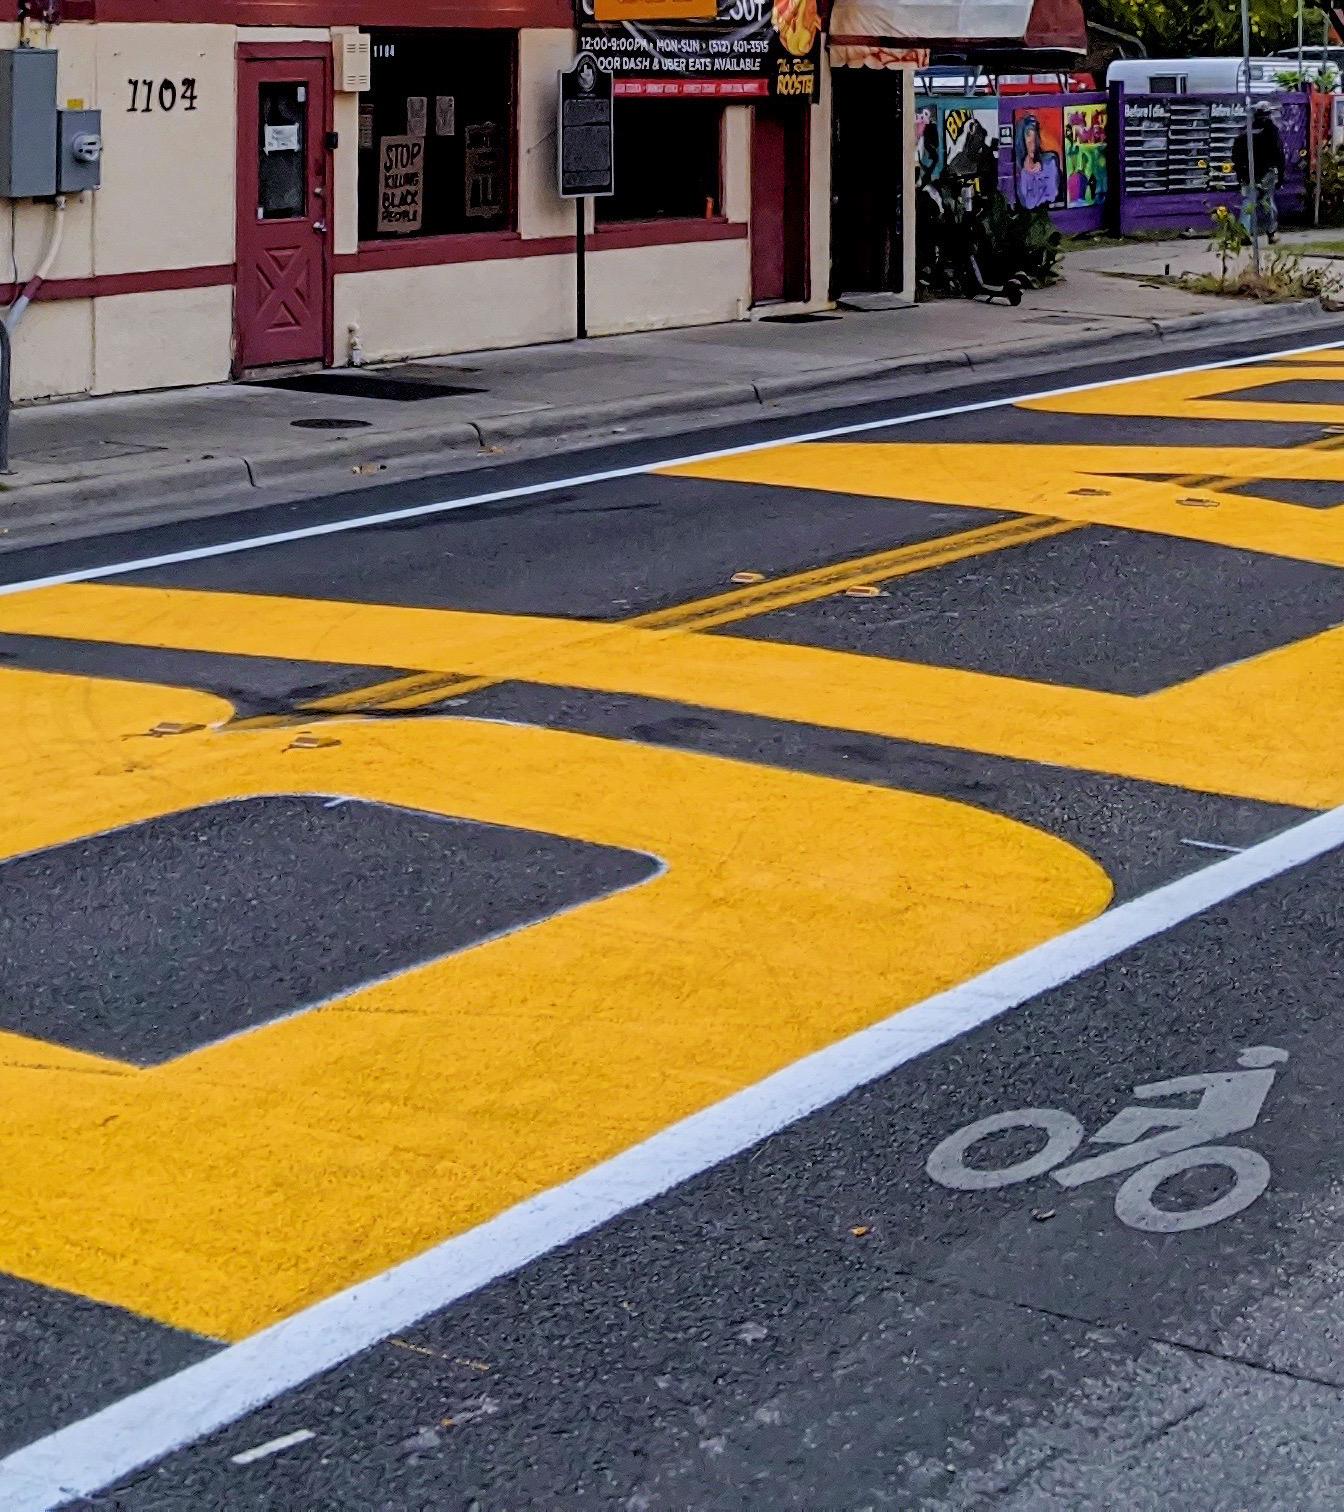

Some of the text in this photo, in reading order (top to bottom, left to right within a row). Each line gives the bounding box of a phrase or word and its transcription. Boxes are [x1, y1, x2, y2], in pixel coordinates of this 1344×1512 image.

[656, 39, 699, 52] MON-SUN
[709, 40, 730, 54] (512)
[597, 57, 621, 70] OOR
[623, 57, 650, 70] DASH
[661, 58, 687, 71] UBER
[689, 58, 712, 71] EATS
[714, 58, 761, 71] AVAILABLE
[126, 77, 197, 112] 1104
[384, 143, 421, 173] STOP
[382, 190, 418, 210] BLACK
